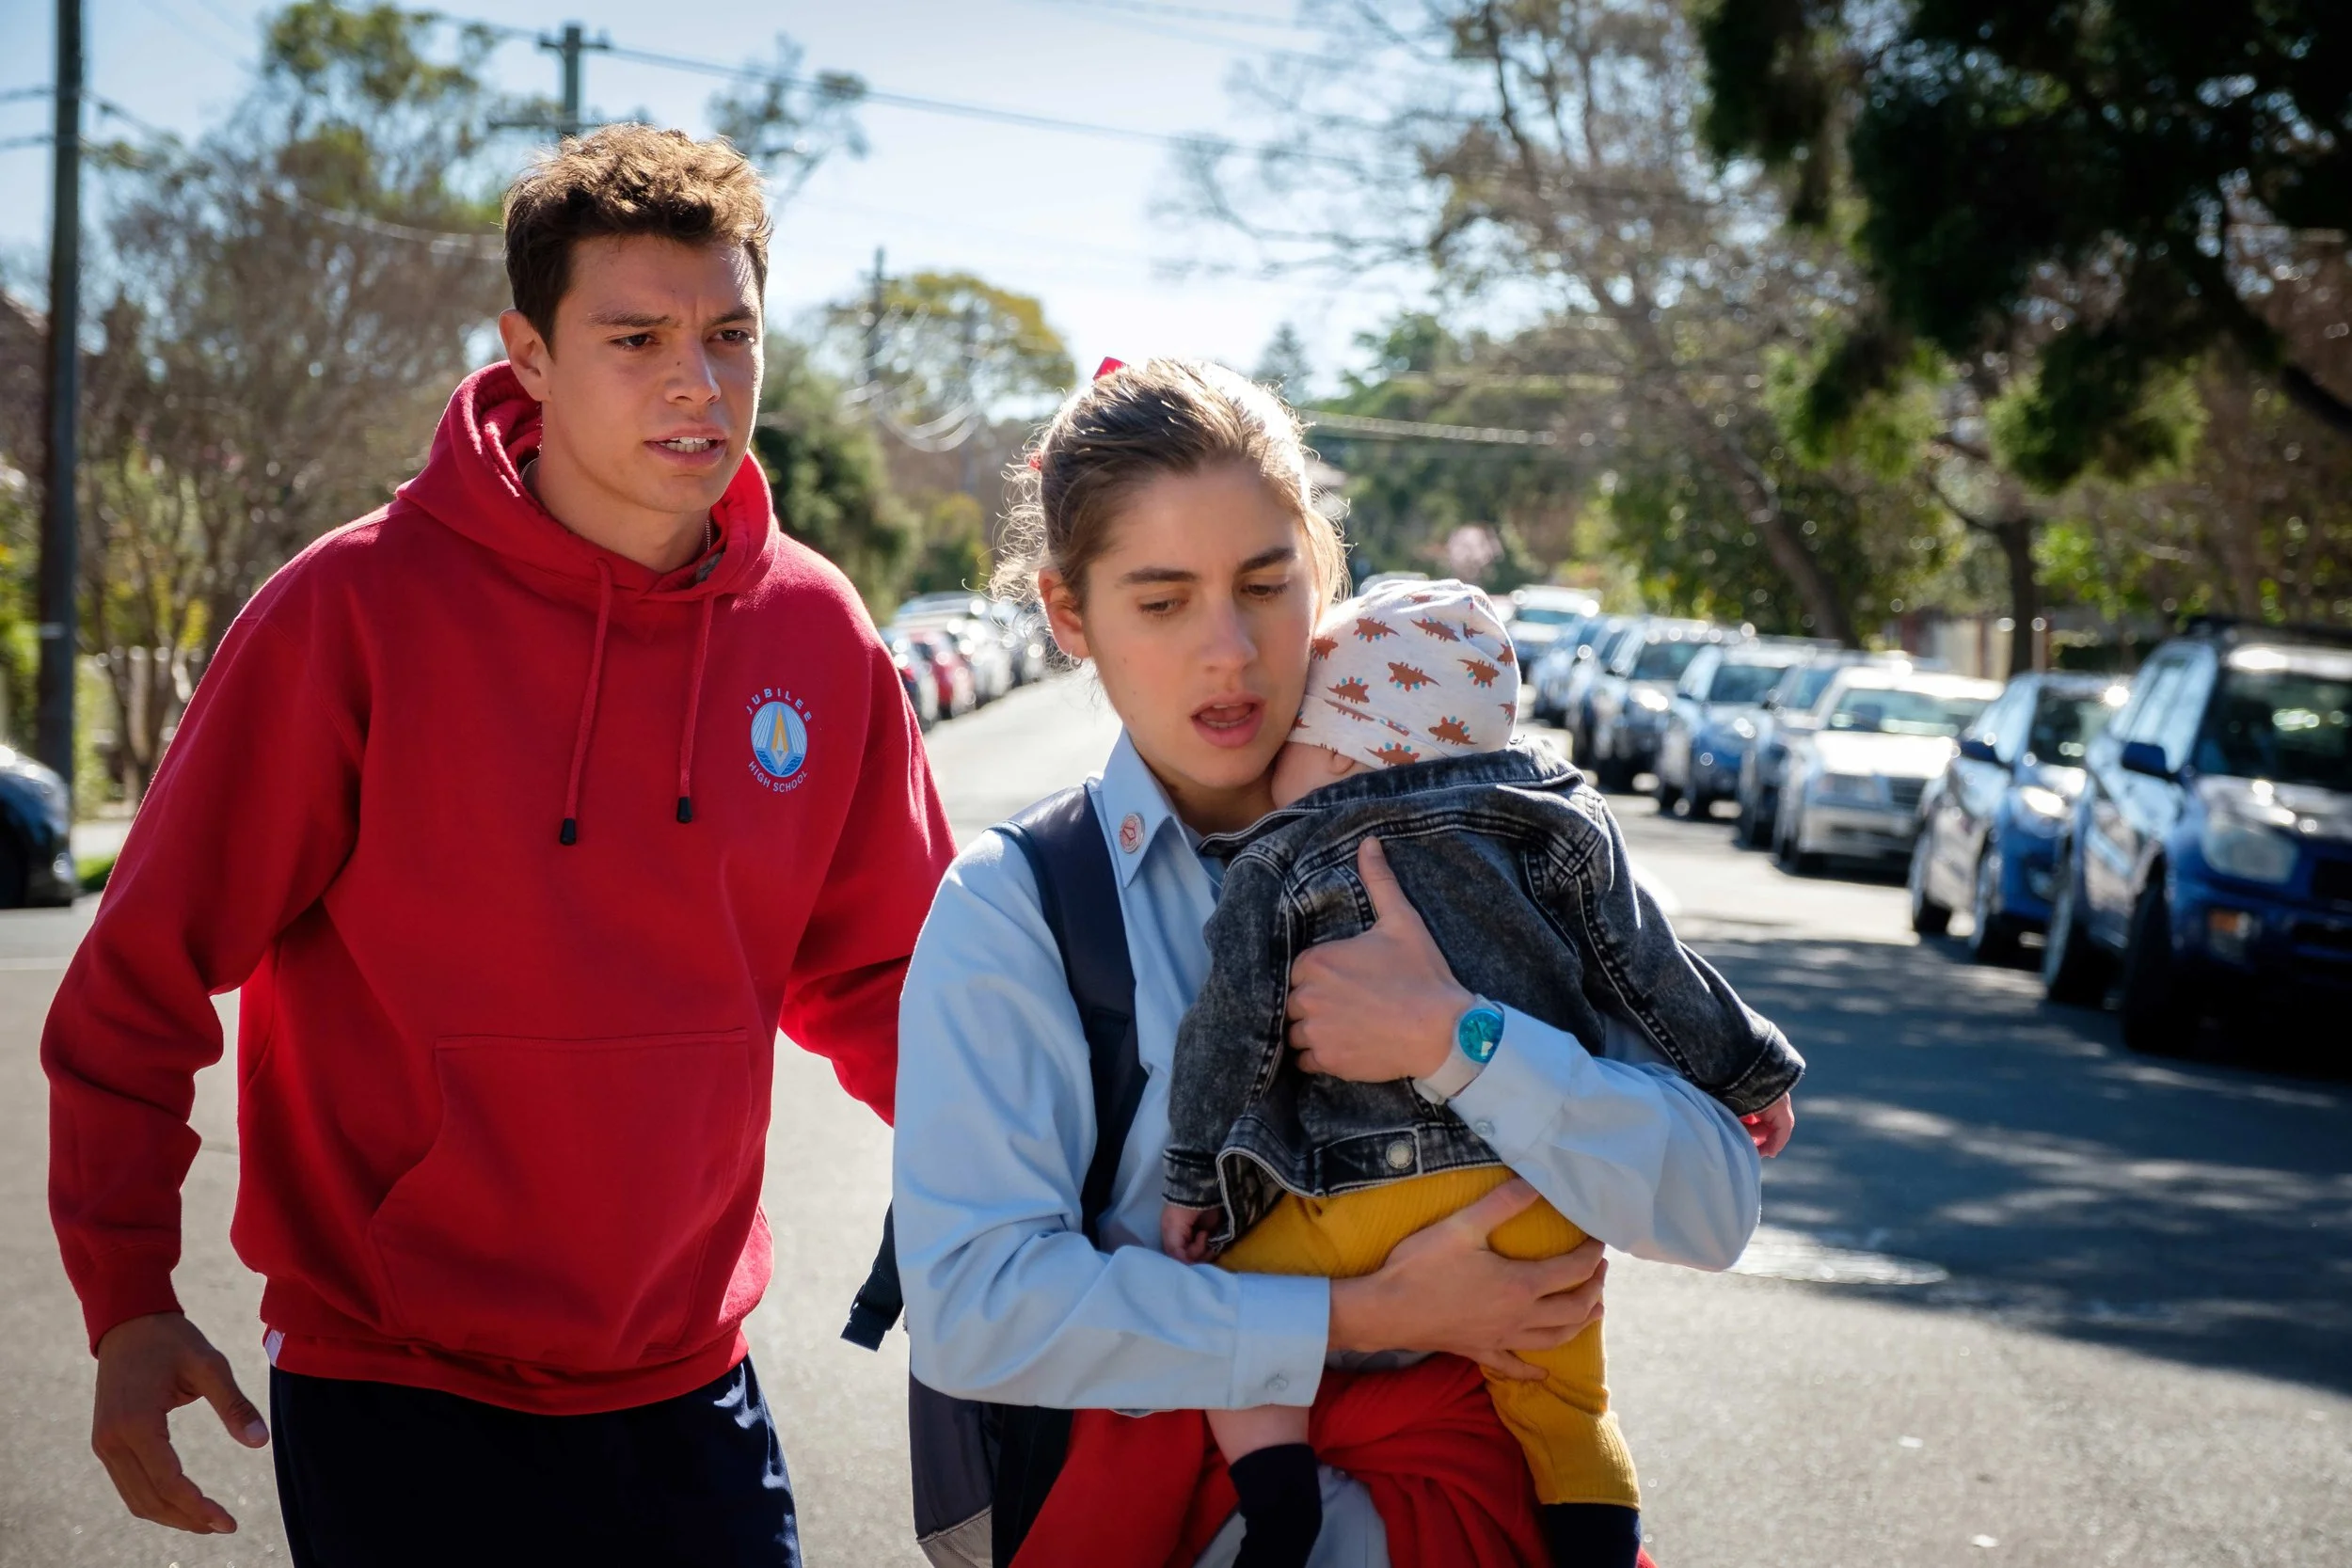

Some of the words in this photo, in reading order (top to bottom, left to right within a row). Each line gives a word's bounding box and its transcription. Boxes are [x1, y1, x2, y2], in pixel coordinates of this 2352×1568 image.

[746, 688, 812, 721] JUBILEE
[748, 760, 771, 787] HIGH
[772, 770, 808, 793] SCHOOL
